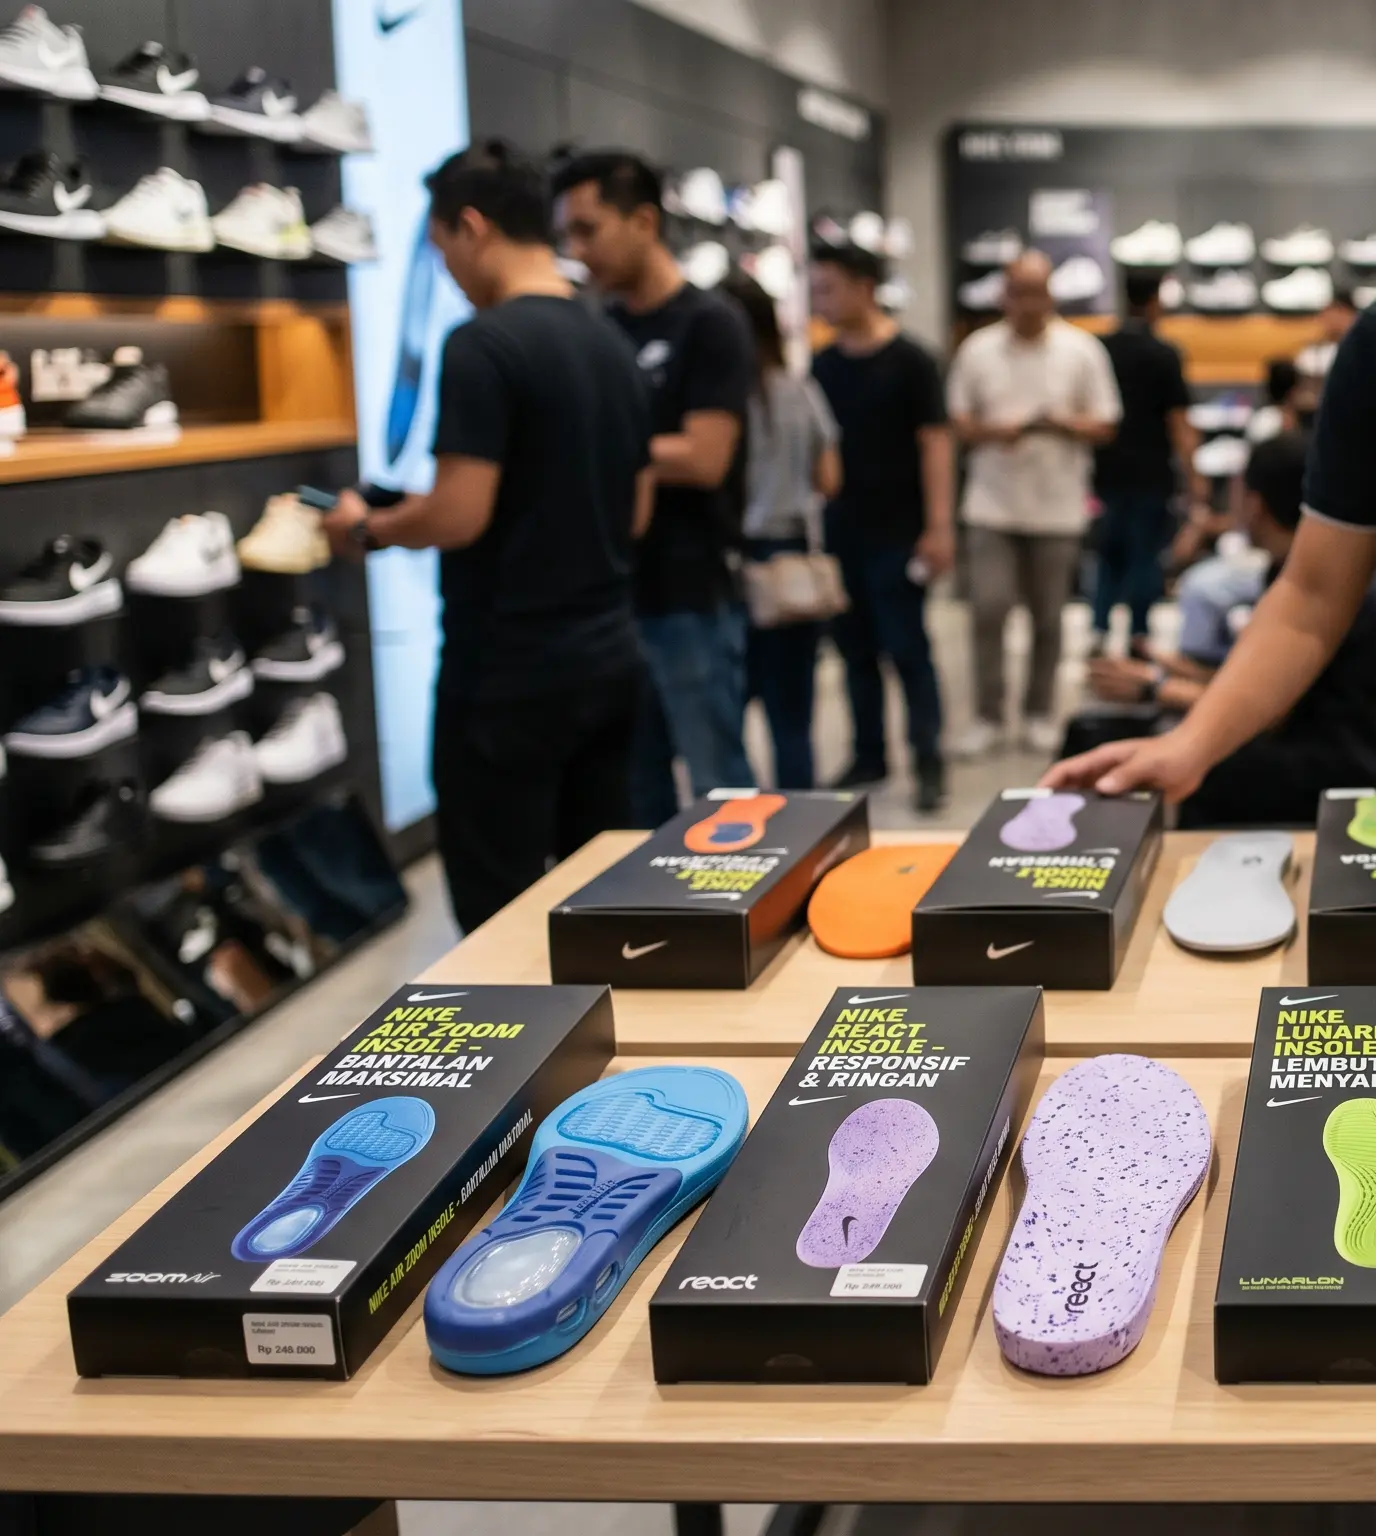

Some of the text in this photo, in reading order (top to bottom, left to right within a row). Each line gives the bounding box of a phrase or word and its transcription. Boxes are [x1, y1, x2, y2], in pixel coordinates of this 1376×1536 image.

[384, 1007, 462, 1022] NIKE
[836, 1008, 908, 1022] NIKE
[1277, 1009, 1345, 1025] NIKE
[367, 1022, 525, 1039] AIR ZOOM
[827, 1023, 926, 1038] REACT
[351, 1038, 467, 1053] INSOLE
[818, 1039, 927, 1054] INSOLE
[334, 1054, 493, 1070] BANTALAN
[808, 1056, 970, 1071] RESPONSIF
[316, 1071, 473, 1088] MAKSIMAL
[798, 1072, 940, 1088] & RINGAN
[390, 1263, 405, 1291] AIR
[428, 1202, 455, 1245] INSOLE
[678, 1274, 759, 1290] react
[1239, 1277, 1344, 1285] LUNARLON
